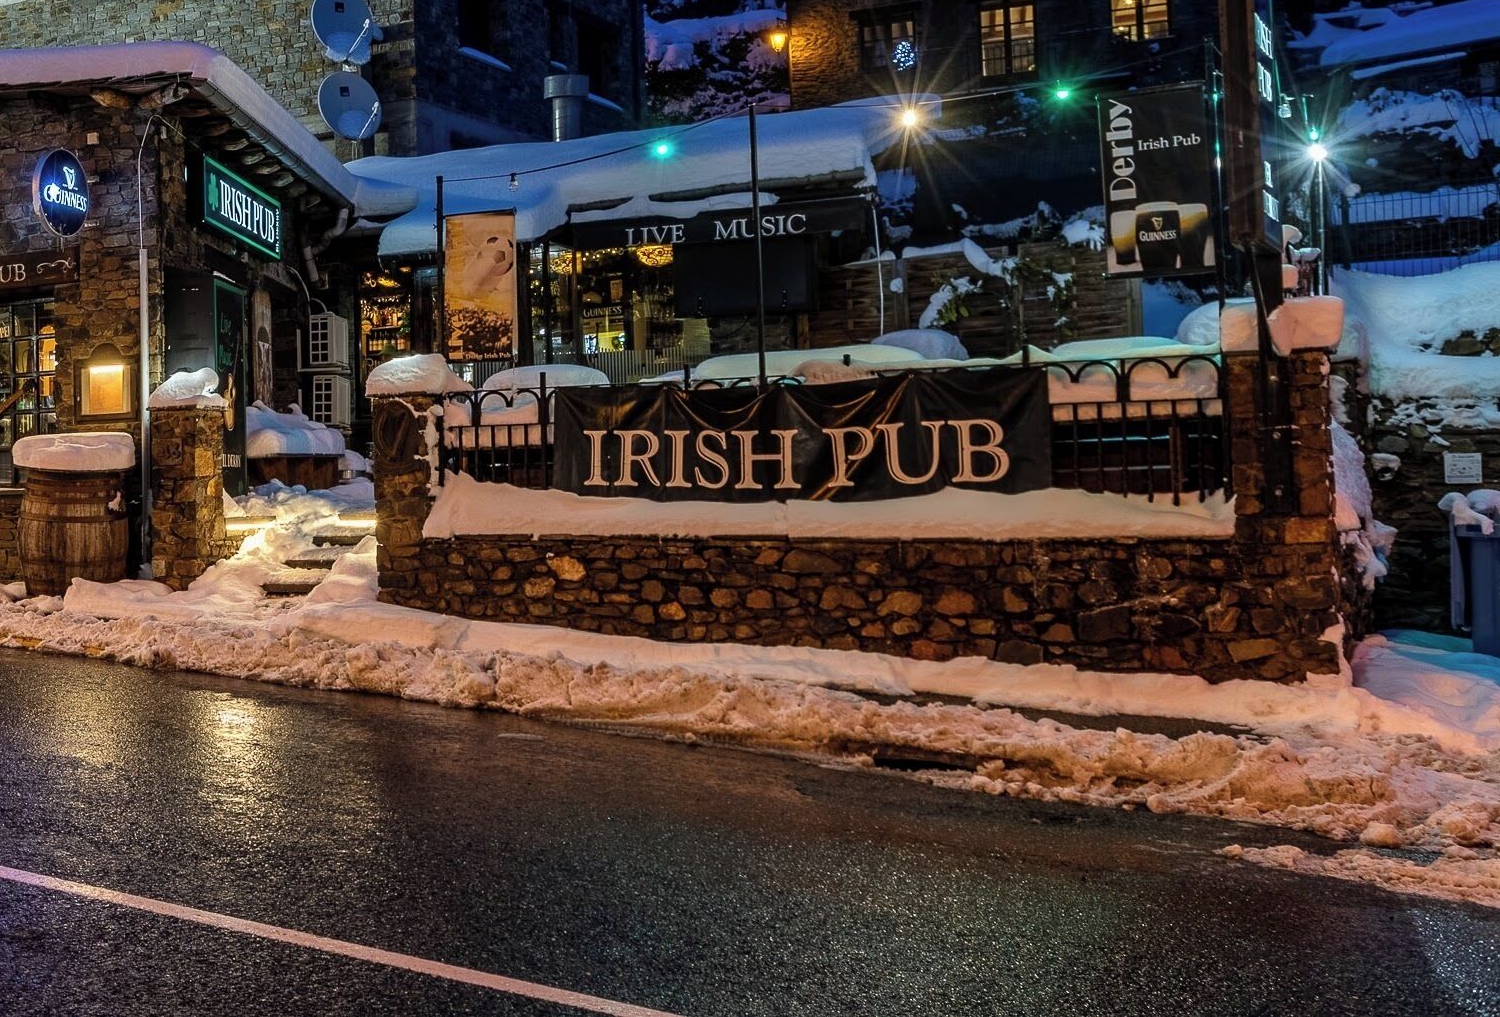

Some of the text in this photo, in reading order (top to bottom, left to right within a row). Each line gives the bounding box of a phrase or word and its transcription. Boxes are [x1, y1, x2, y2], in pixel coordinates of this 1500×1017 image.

[1106, 99, 1137, 202] Derby
[1137, 133, 1201, 151] Irish Pub
[43, 184, 87, 212] GUINNESS
[220, 179, 275, 243] IRISH PUB
[625, 214, 806, 247] LIVE MUSIC
[1139, 231, 1177, 242] GUINNESS
[583, 306, 623, 318] GUINNESS
[583, 419, 1010, 490] IRISH PUB
